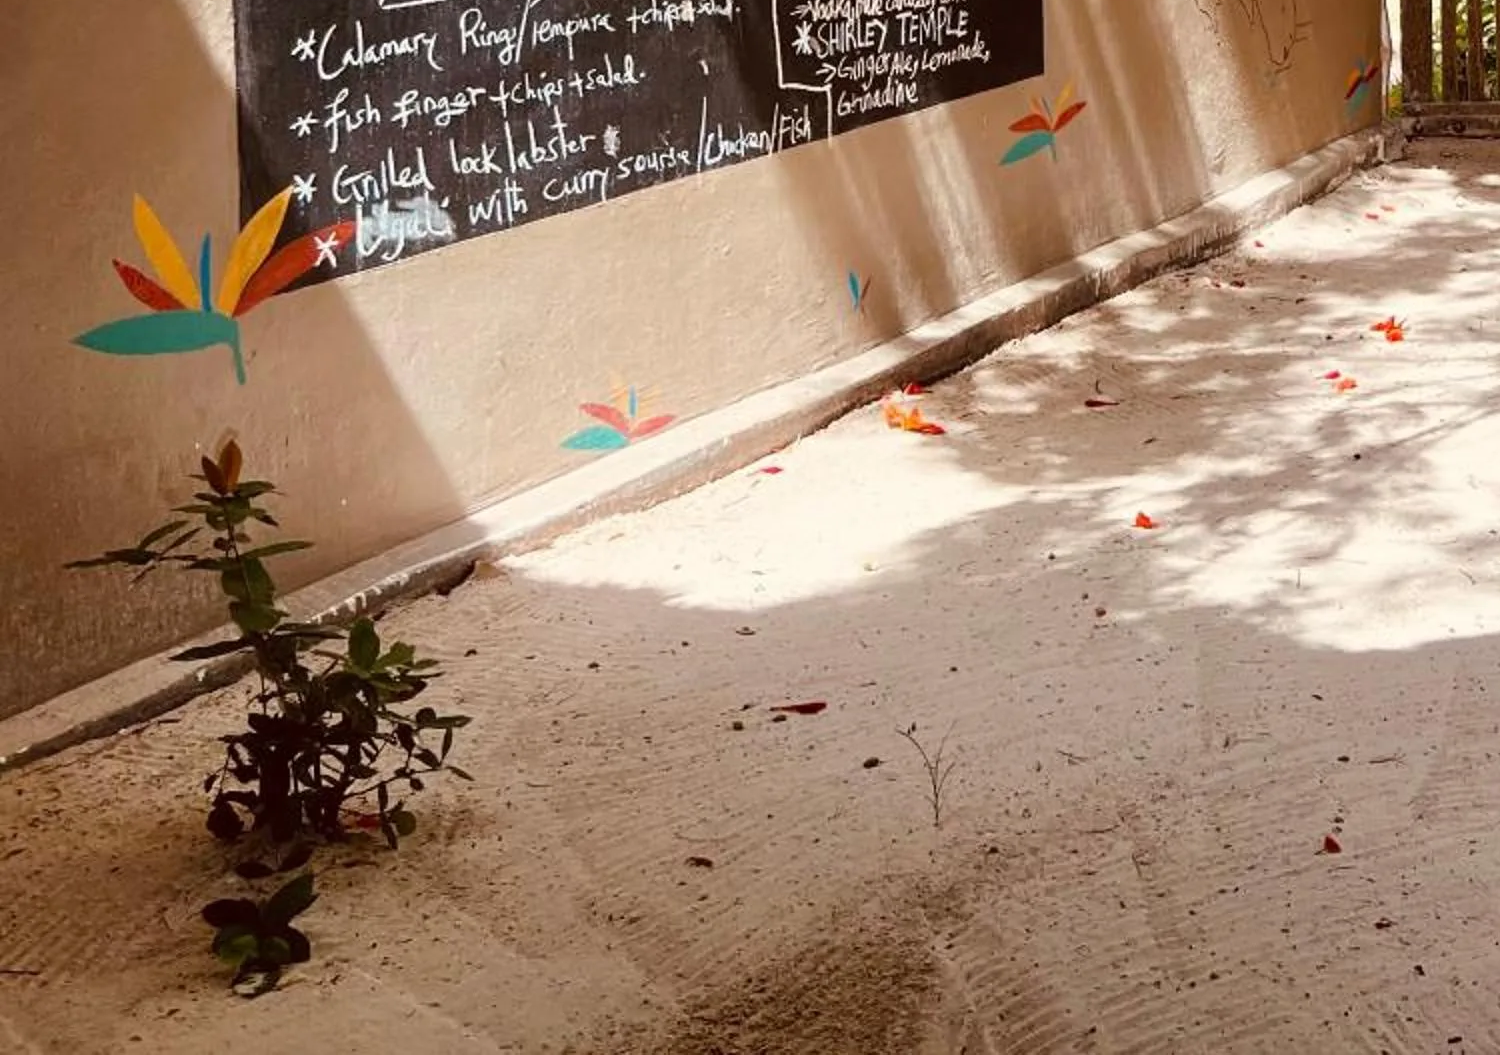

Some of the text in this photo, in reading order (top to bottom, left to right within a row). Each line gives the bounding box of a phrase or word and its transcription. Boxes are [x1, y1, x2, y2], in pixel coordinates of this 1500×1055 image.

[317, 20, 445, 81] Calamary
[814, 5, 969, 59] SHIRLEY TEMPLE
